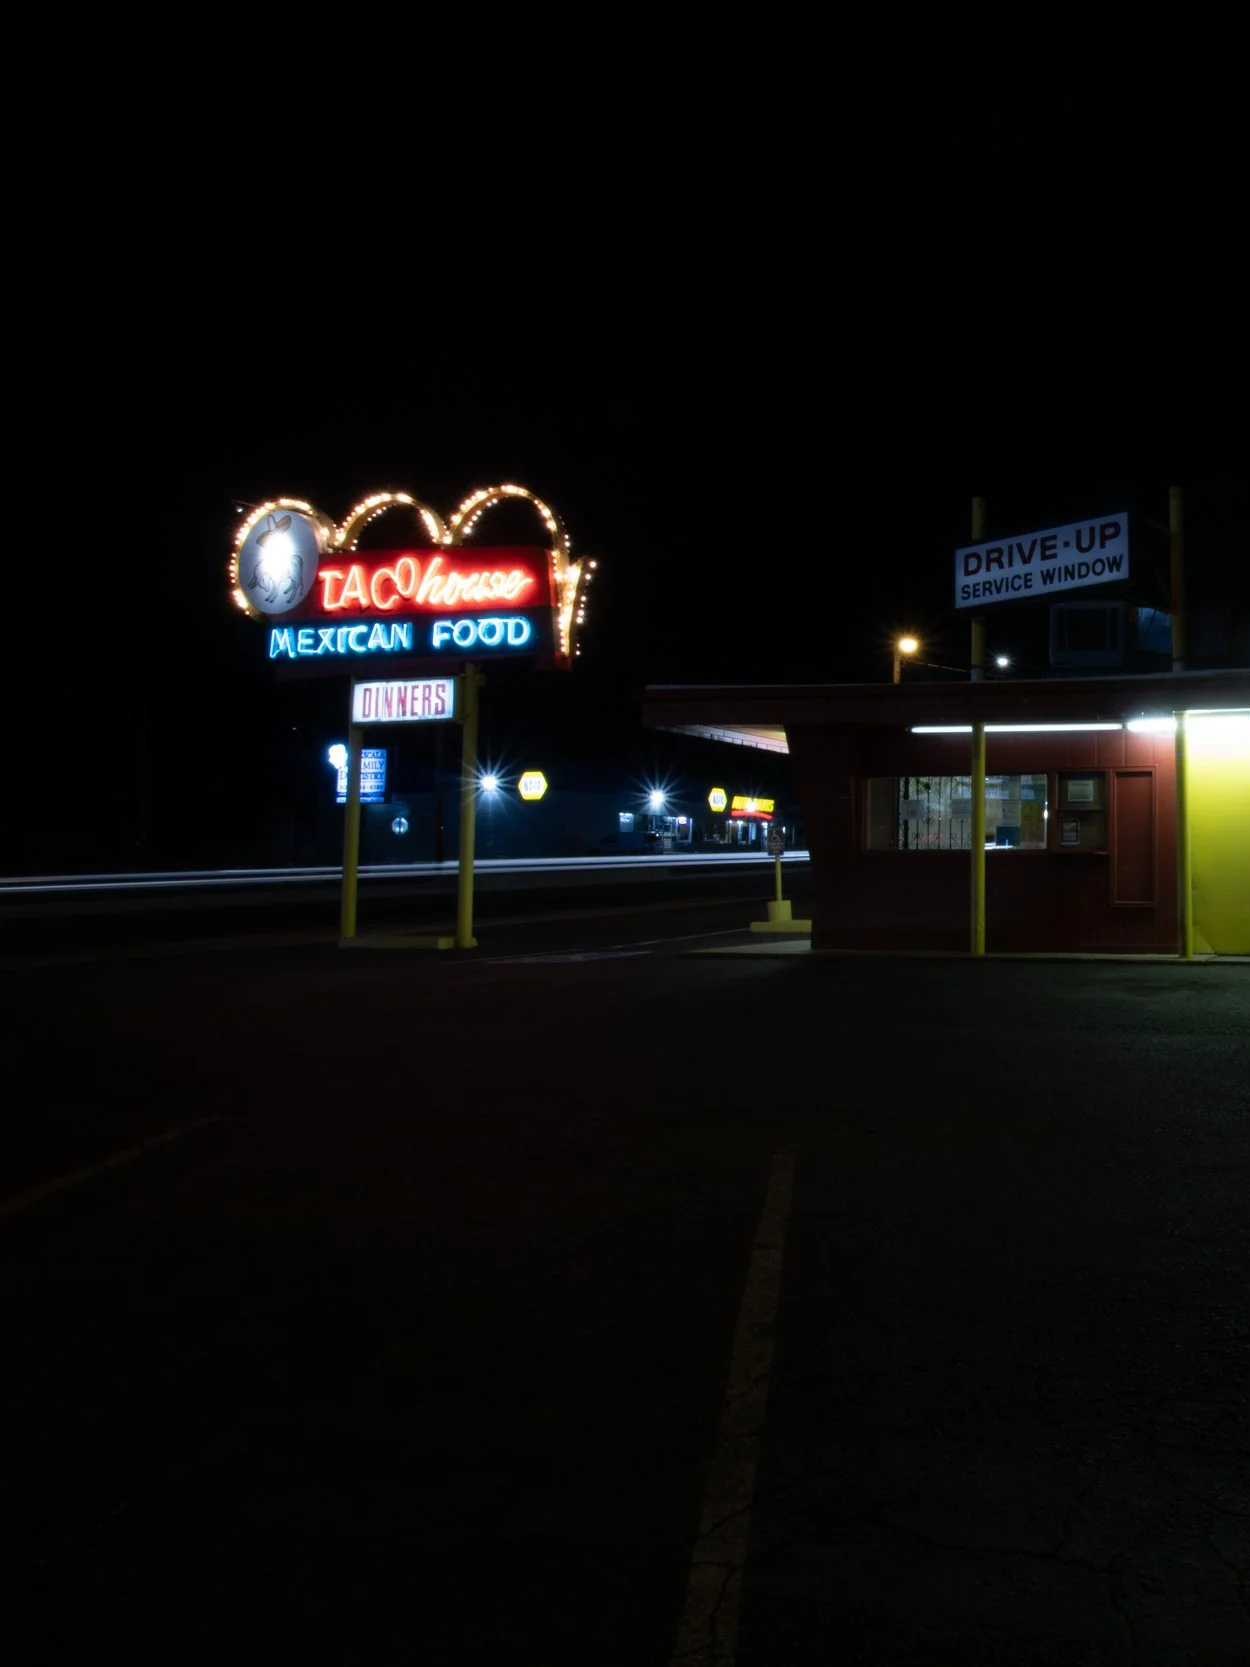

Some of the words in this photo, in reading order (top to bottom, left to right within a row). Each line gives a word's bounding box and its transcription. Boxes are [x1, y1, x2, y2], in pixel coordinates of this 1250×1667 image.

[963, 520, 1122, 577] DRIVE-UP
[961, 572, 1033, 601] SERVICE
[1041, 554, 1124, 585] WINDOW
[269, 622, 413, 659] MEXICAN
[432, 616, 532, 649] FOOD
[362, 683, 447, 719] DINNERS
